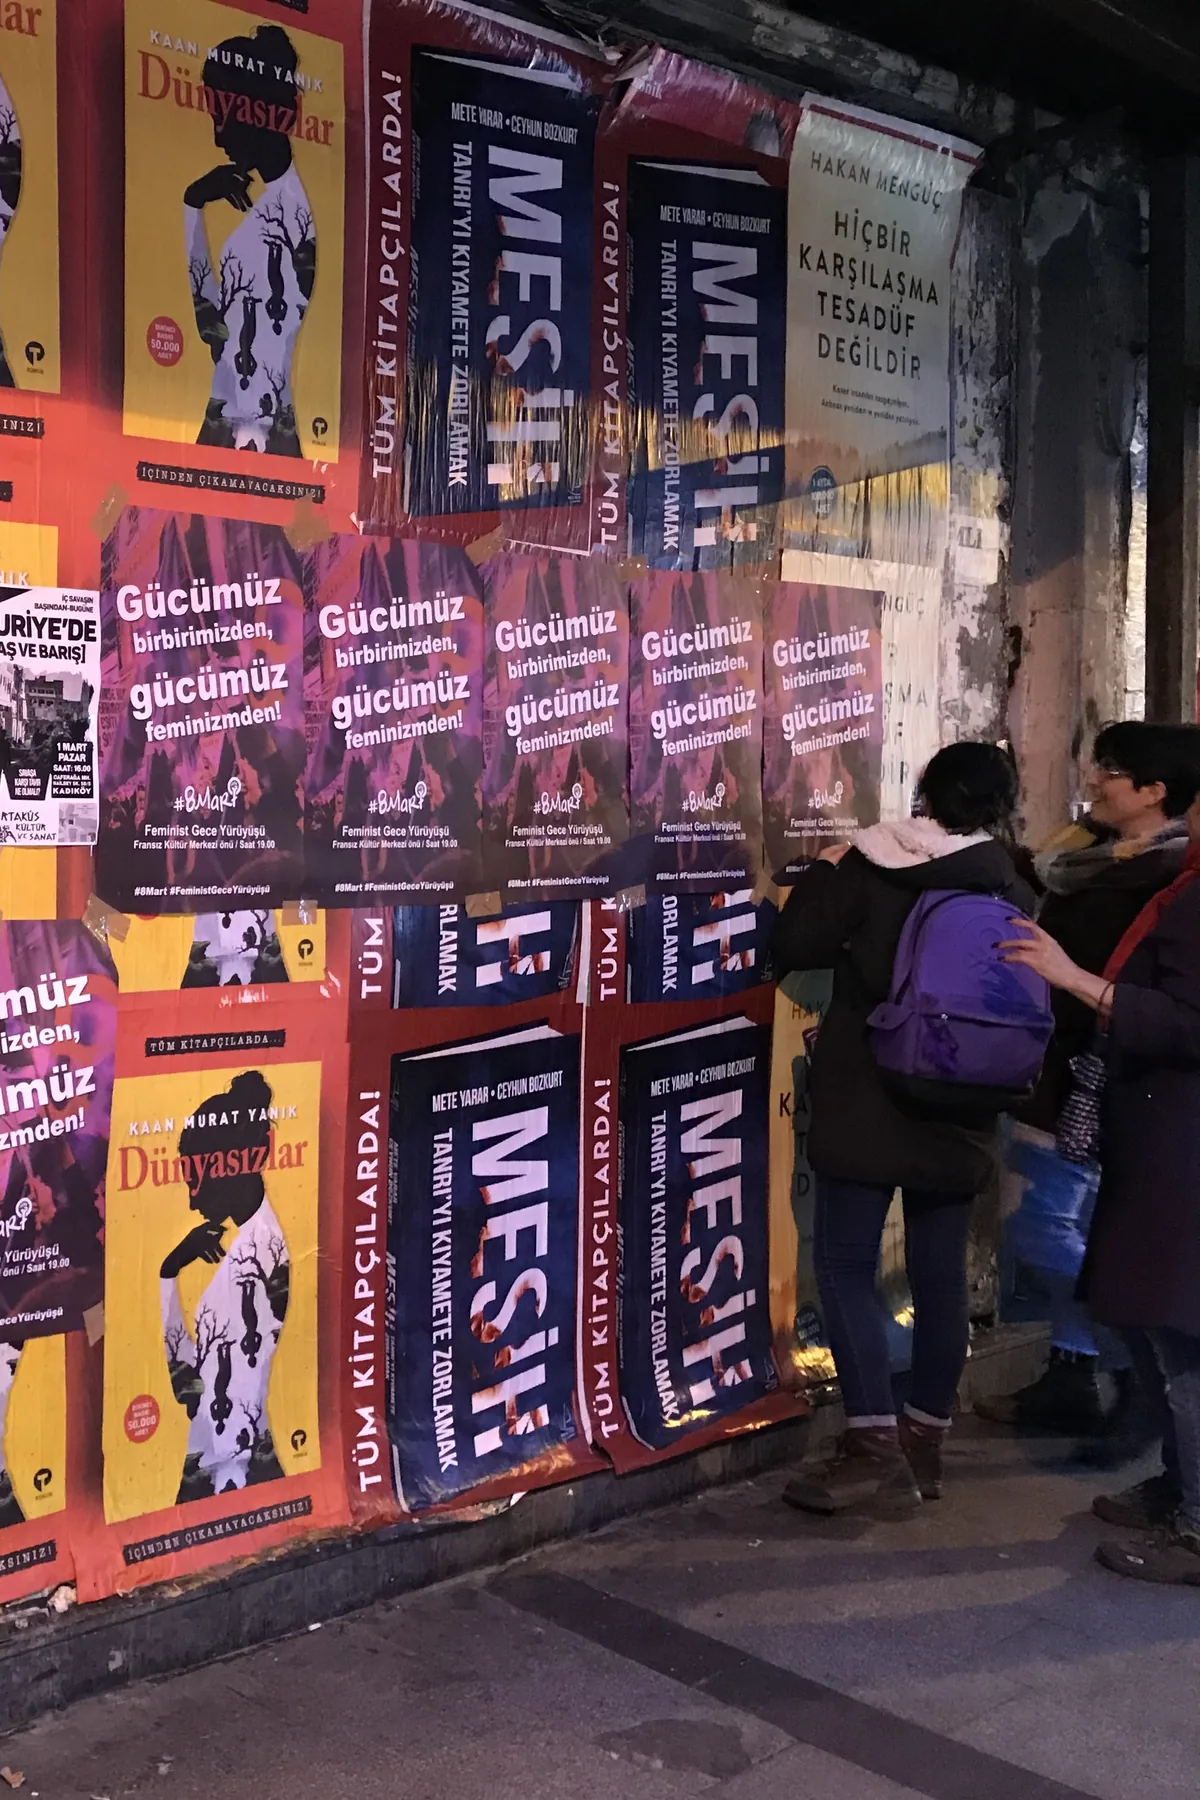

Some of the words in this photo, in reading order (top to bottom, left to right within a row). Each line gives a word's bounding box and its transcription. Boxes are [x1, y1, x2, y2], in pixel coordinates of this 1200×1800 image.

[150, 30, 198, 55] KAAN
[208, 48, 266, 74] MURAT
[274, 65, 324, 94] YANIK
[138, 49, 334, 146] Dünyasızlar
[451, 102, 477, 123] METE
[478, 108, 503, 130] YARAR
[511, 115, 543, 138] CEYHUN
[544, 121, 579, 145] BOZKURT
[810, 150, 870, 184] HAKAN
[875, 171, 944, 210] MENGÜÇ
[373, 69, 405, 378] KİTAPÇILARDA!
[660, 205, 680, 224] METE
[682, 207, 706, 227] YARAR
[712, 211, 740, 231] CEYHUN
[740, 214, 771, 234] BOZKURT
[833, 209, 911, 258] HİÇBİR
[799, 243, 939, 307] KARŞILAŞMA
[451, 243, 470, 358] KIYAMETE
[601, 181, 620, 455] KİTAPÇILARDA!
[817, 290, 916, 338] TESADÜF
[817, 332, 922, 381] DEĞİLDİR
[371, 395, 396, 478] TÜM
[447, 365, 469, 488] ZORLAMAK
[141, 467, 194, 486] İÇİNDEN
[198, 472, 322, 500] ÇIKAMAYACAKSINIZ!
[663, 438, 679, 552] ZORLAMAK
[598, 472, 619, 546] TÜM
[116, 572, 281, 622] Gücümüz
[319, 592, 465, 639] Gücümüz
[19, 644, 37, 658] VE
[133, 618, 273, 655] birbirimizden,
[335, 635, 457, 668] birbirimizden,
[495, 605, 617, 653] Gücümüz
[642, 617, 753, 662] Gücümüz
[772, 625, 870, 668] Gücümüz
[507, 645, 611, 681] birbirimizden,
[652, 654, 749, 687] birbirimizden,
[781, 660, 867, 691] birbirimizden,
[130, 657, 289, 720] gücümüz
[331, 670, 470, 729] gücümüz
[505, 680, 620, 737] gücümüz
[145, 701, 281, 743] feminizmden!
[344, 710, 464, 750] feminizmden!
[516, 718, 614, 756] feminizmden!
[650, 687, 757, 741] gücümüz
[661, 719, 752, 758] feminizmden!
[781, 690, 875, 742] gücümüz
[58, 753, 86, 762] PAZAR
[791, 721, 871, 757] feminizmden!
[53, 787, 92, 795] KADIKÖY
[150, 1040, 177, 1053] TÜM
[432, 1089, 457, 1113] METE
[459, 1086, 489, 1107] YARAR
[496, 1077, 527, 1102] CEYHUN
[528, 1069, 564, 1095] BOZKURT
[650, 1078, 671, 1097] METE
[672, 1073, 694, 1093] YARAR
[699, 1064, 725, 1086] CEYHUN
[726, 1056, 756, 1080] BOZKURT
[128, 1116, 175, 1137] KAAN
[184, 1109, 239, 1131] MURAT
[247, 1103, 298, 1122] YANIK
[117, 1137, 309, 1196] Dünyasızlar
[592, 1078, 612, 1347] KİTAPÇILARDA!
[347, 1089, 382, 1389] KİTAPÇILARDA!
[649, 1200, 666, 1300] KIYAMETE
[431, 1230, 451, 1338] KIYAMETE
[432, 1341, 458, 1473] ZORLAMAK
[594, 1366, 618, 1440] TÜM
[351, 1405, 383, 1493] TÜM
[128, 1533, 180, 1562] İÇİNDEN
[184, 1499, 308, 1545] ÇIKAMAYACAKSINIZ!
